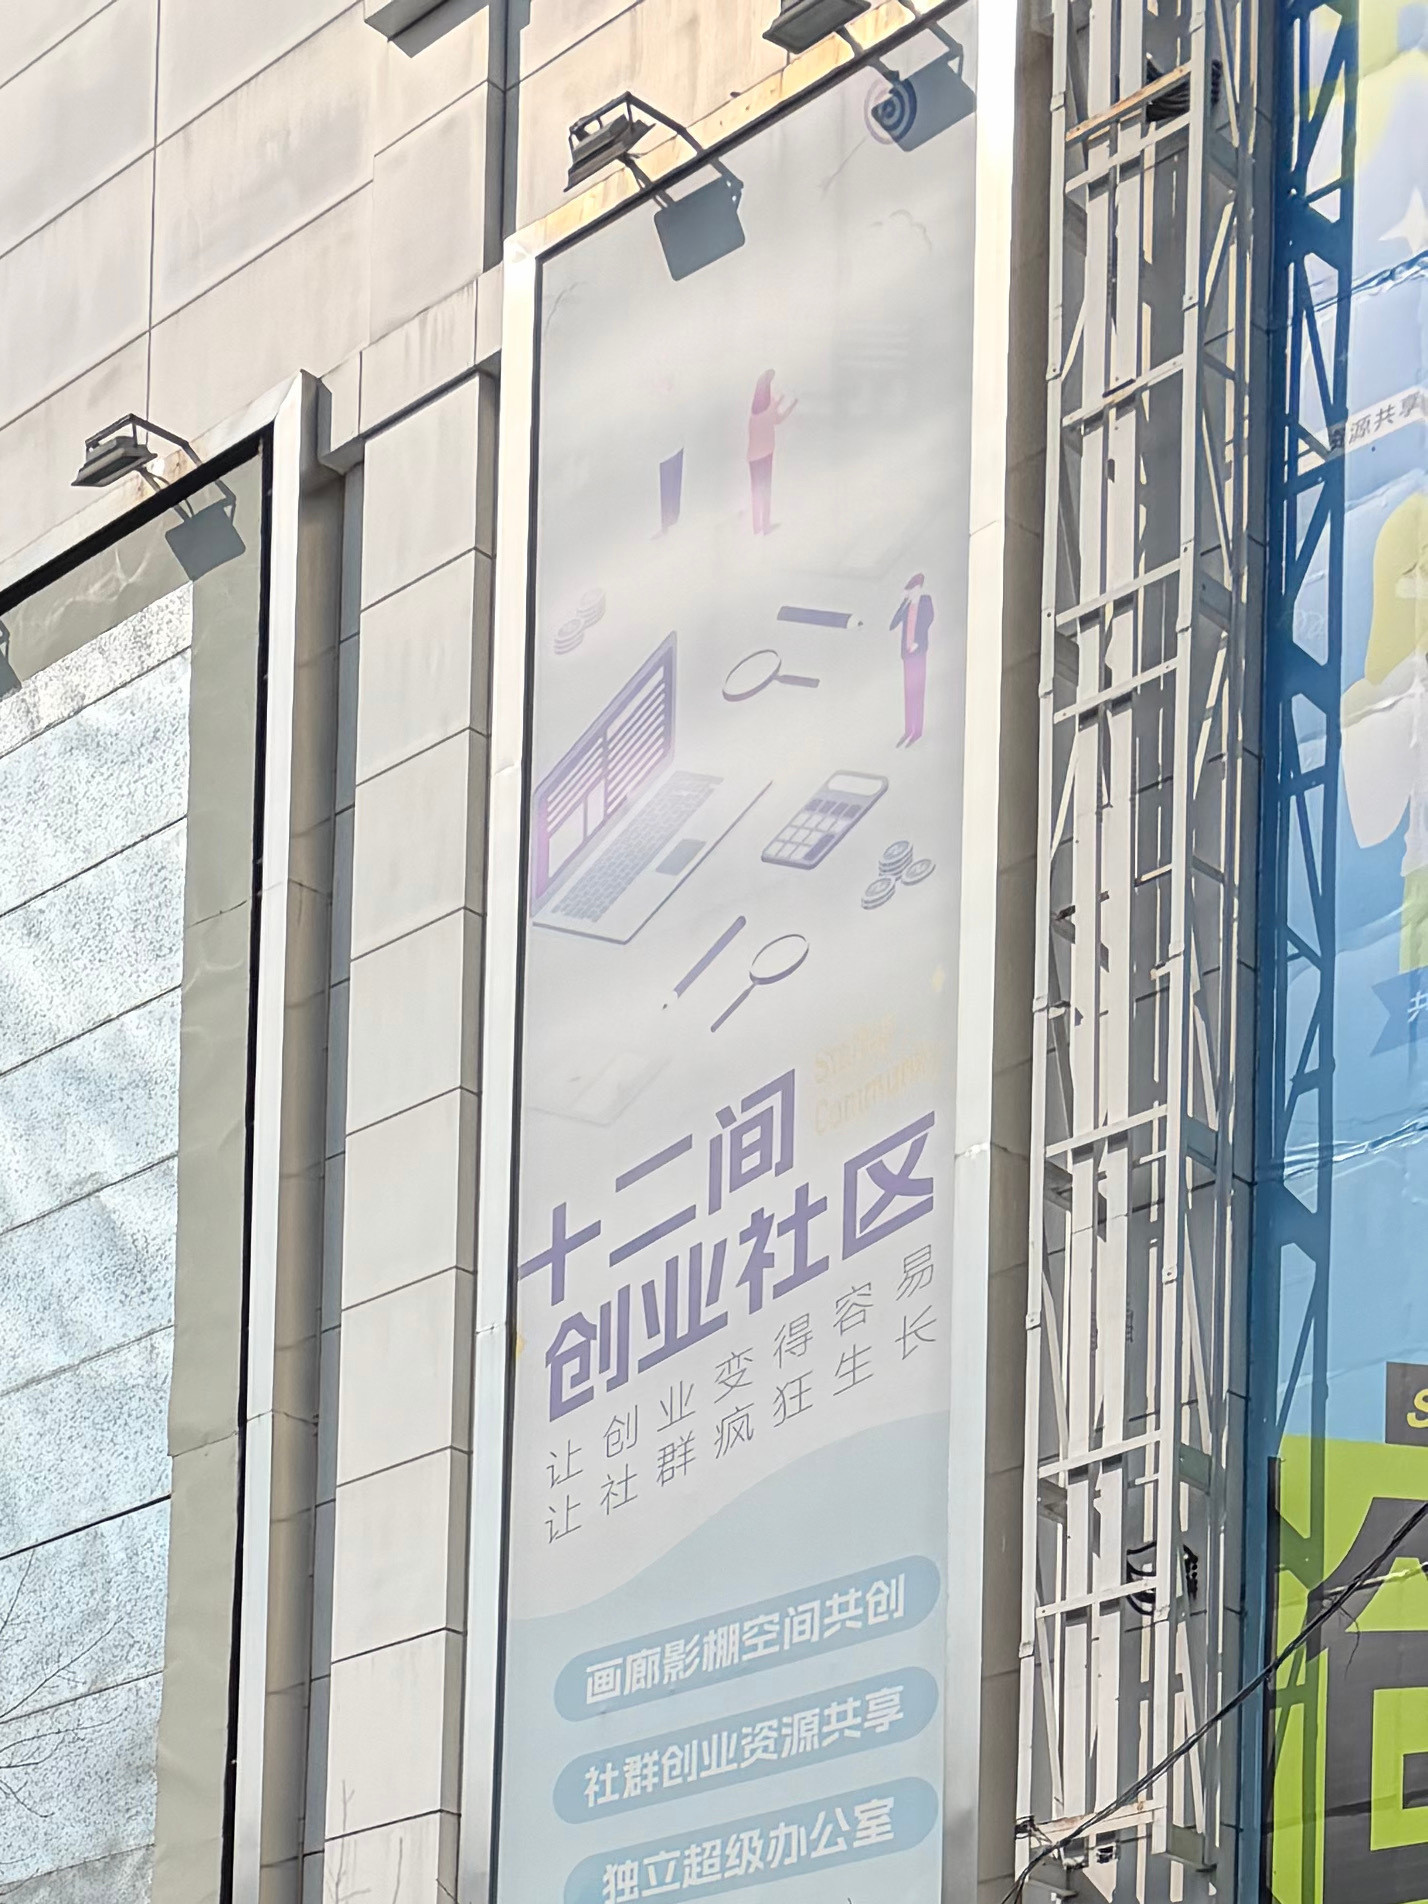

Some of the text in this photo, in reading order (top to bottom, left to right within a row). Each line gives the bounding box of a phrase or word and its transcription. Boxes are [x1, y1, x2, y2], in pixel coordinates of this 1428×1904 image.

[519, 1068, 796, 1306] 十二间
[545, 1110, 935, 1423] 创业社区
[546, 1243, 935, 1489] 让创业变得容易
[546, 1304, 938, 1544] 让社群疯狂生长
[584, 1685, 905, 1808] 社群创业资源共享
[585, 1573, 906, 1705] 画廊影棚空间共创
